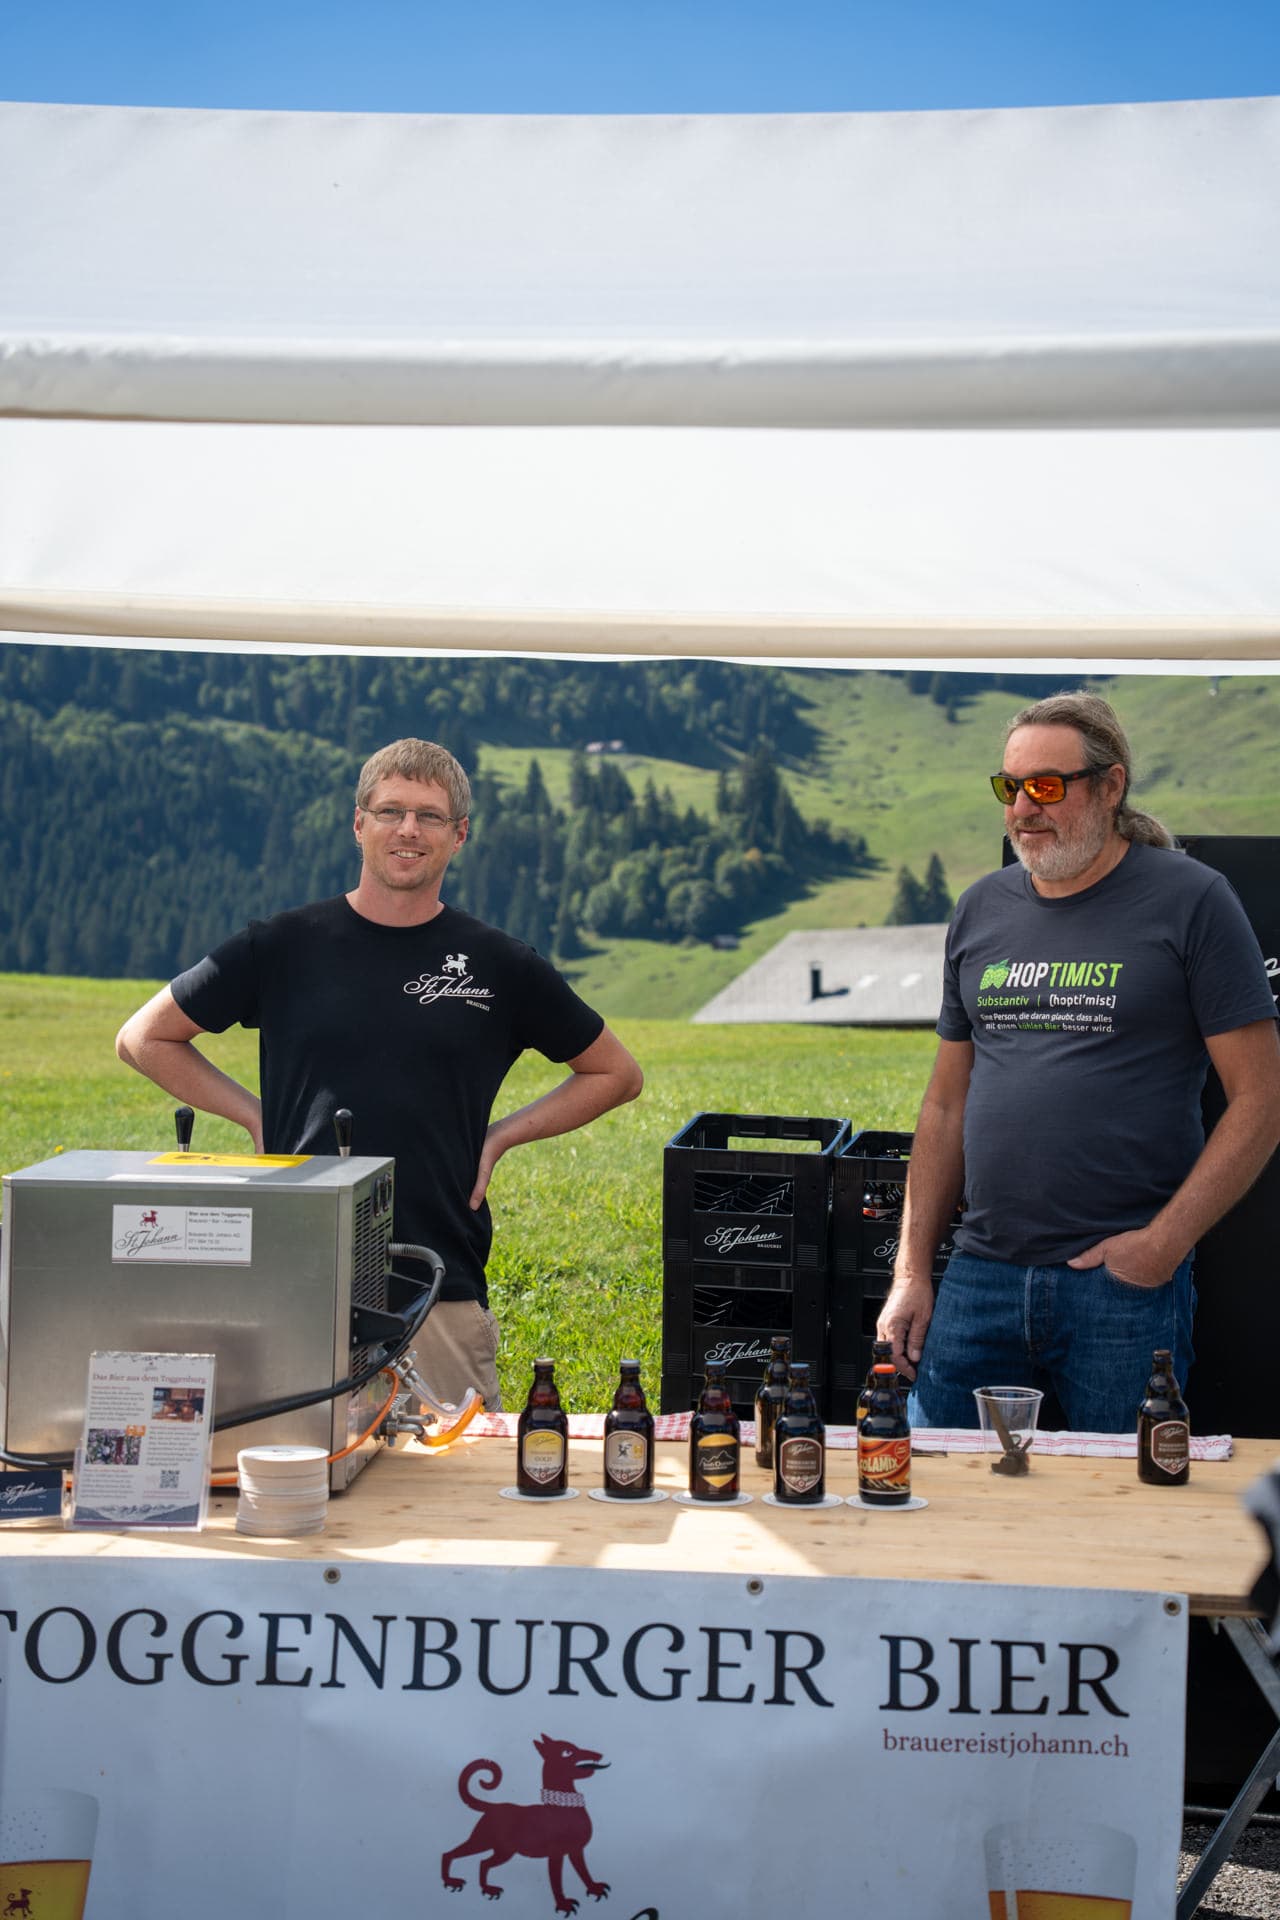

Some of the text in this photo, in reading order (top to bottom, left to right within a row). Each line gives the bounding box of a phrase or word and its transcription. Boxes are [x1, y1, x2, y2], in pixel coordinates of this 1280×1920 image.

[1006, 962, 1124, 988] HOPTIMIST
[977, 994, 1030, 1007] Substantiv
[993, 1013, 1018, 1021] Person,
[1019, 1013, 1030, 1021] die
[1030, 1012, 1050, 1020] daran
[1076, 1013, 1093, 1022] dass
[1093, 1014, 1113, 1023] alles
[1062, 1023, 1089, 1032] besser
[1092, 1024, 1115, 1033] wird.
[92, 1373, 108, 1381] Das
[109, 1373, 125, 1381] Bier
[141, 1374, 159, 1382] dem
[161, 1375, 208, 1385] Toggenburg
[879, 1634, 1130, 1718] BIER
[883, 1728, 1129, 1758] brauereistjohann.ch
